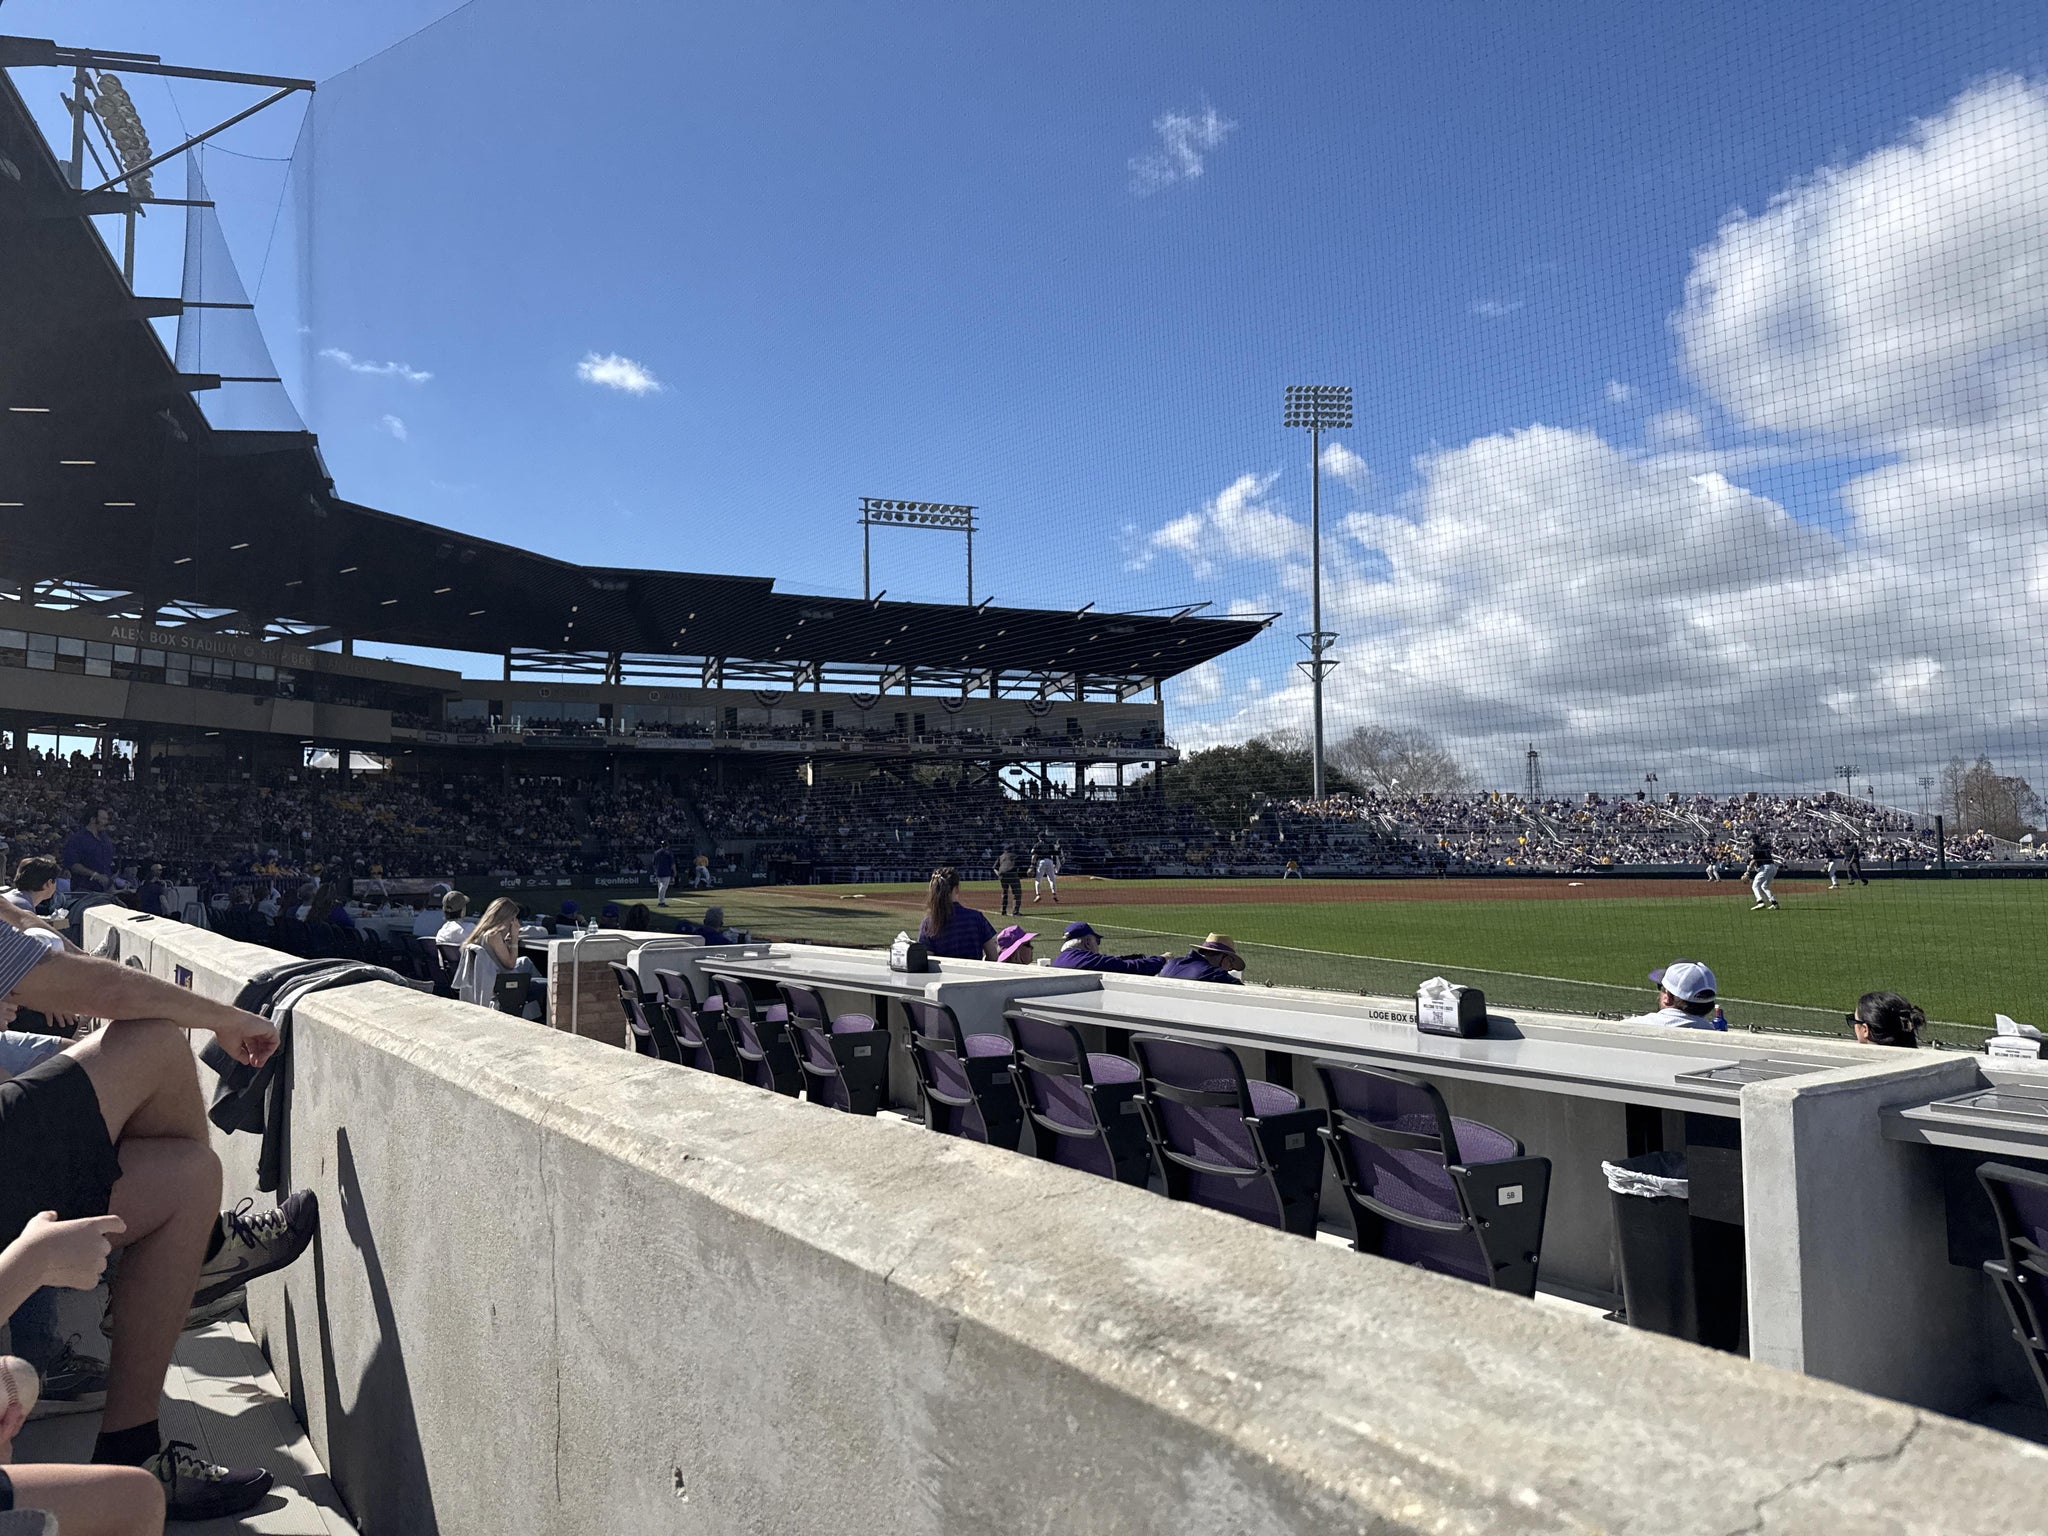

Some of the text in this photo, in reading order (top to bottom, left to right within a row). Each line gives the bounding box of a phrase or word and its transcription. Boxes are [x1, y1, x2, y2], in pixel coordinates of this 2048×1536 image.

[111, 626, 144, 641] ALEX
[150, 632, 176, 646] BOX
[181, 636, 236, 655] STADIUM
[595, 876, 639, 886] ExxonMobil
[1369, 1010, 1389, 1020] LOGE
[1391, 1012, 1407, 1022] BOX
